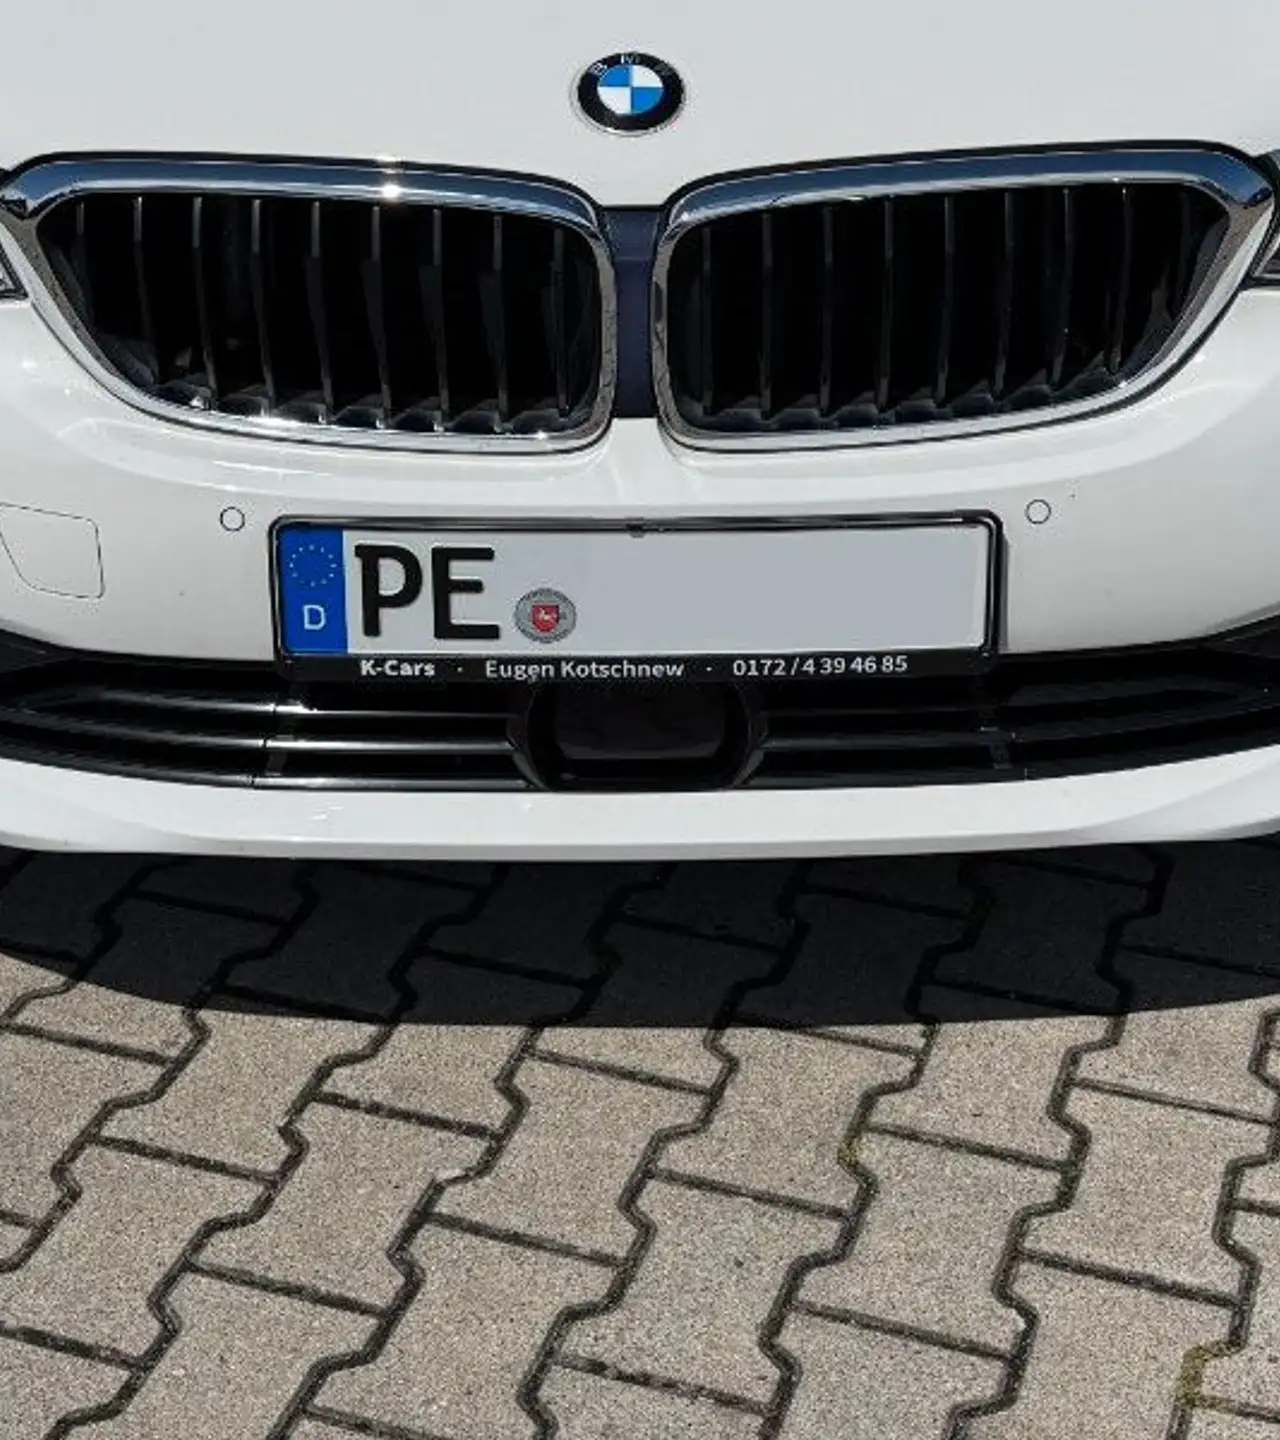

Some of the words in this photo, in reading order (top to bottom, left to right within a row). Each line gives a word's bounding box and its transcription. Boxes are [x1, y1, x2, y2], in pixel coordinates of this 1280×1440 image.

[354, 543, 501, 640] PE
[303, 603, 327, 631] D
[359, 660, 436, 677] K-Cars
[485, 660, 555, 682] Eugen
[561, 660, 685, 679] Kotschnew
